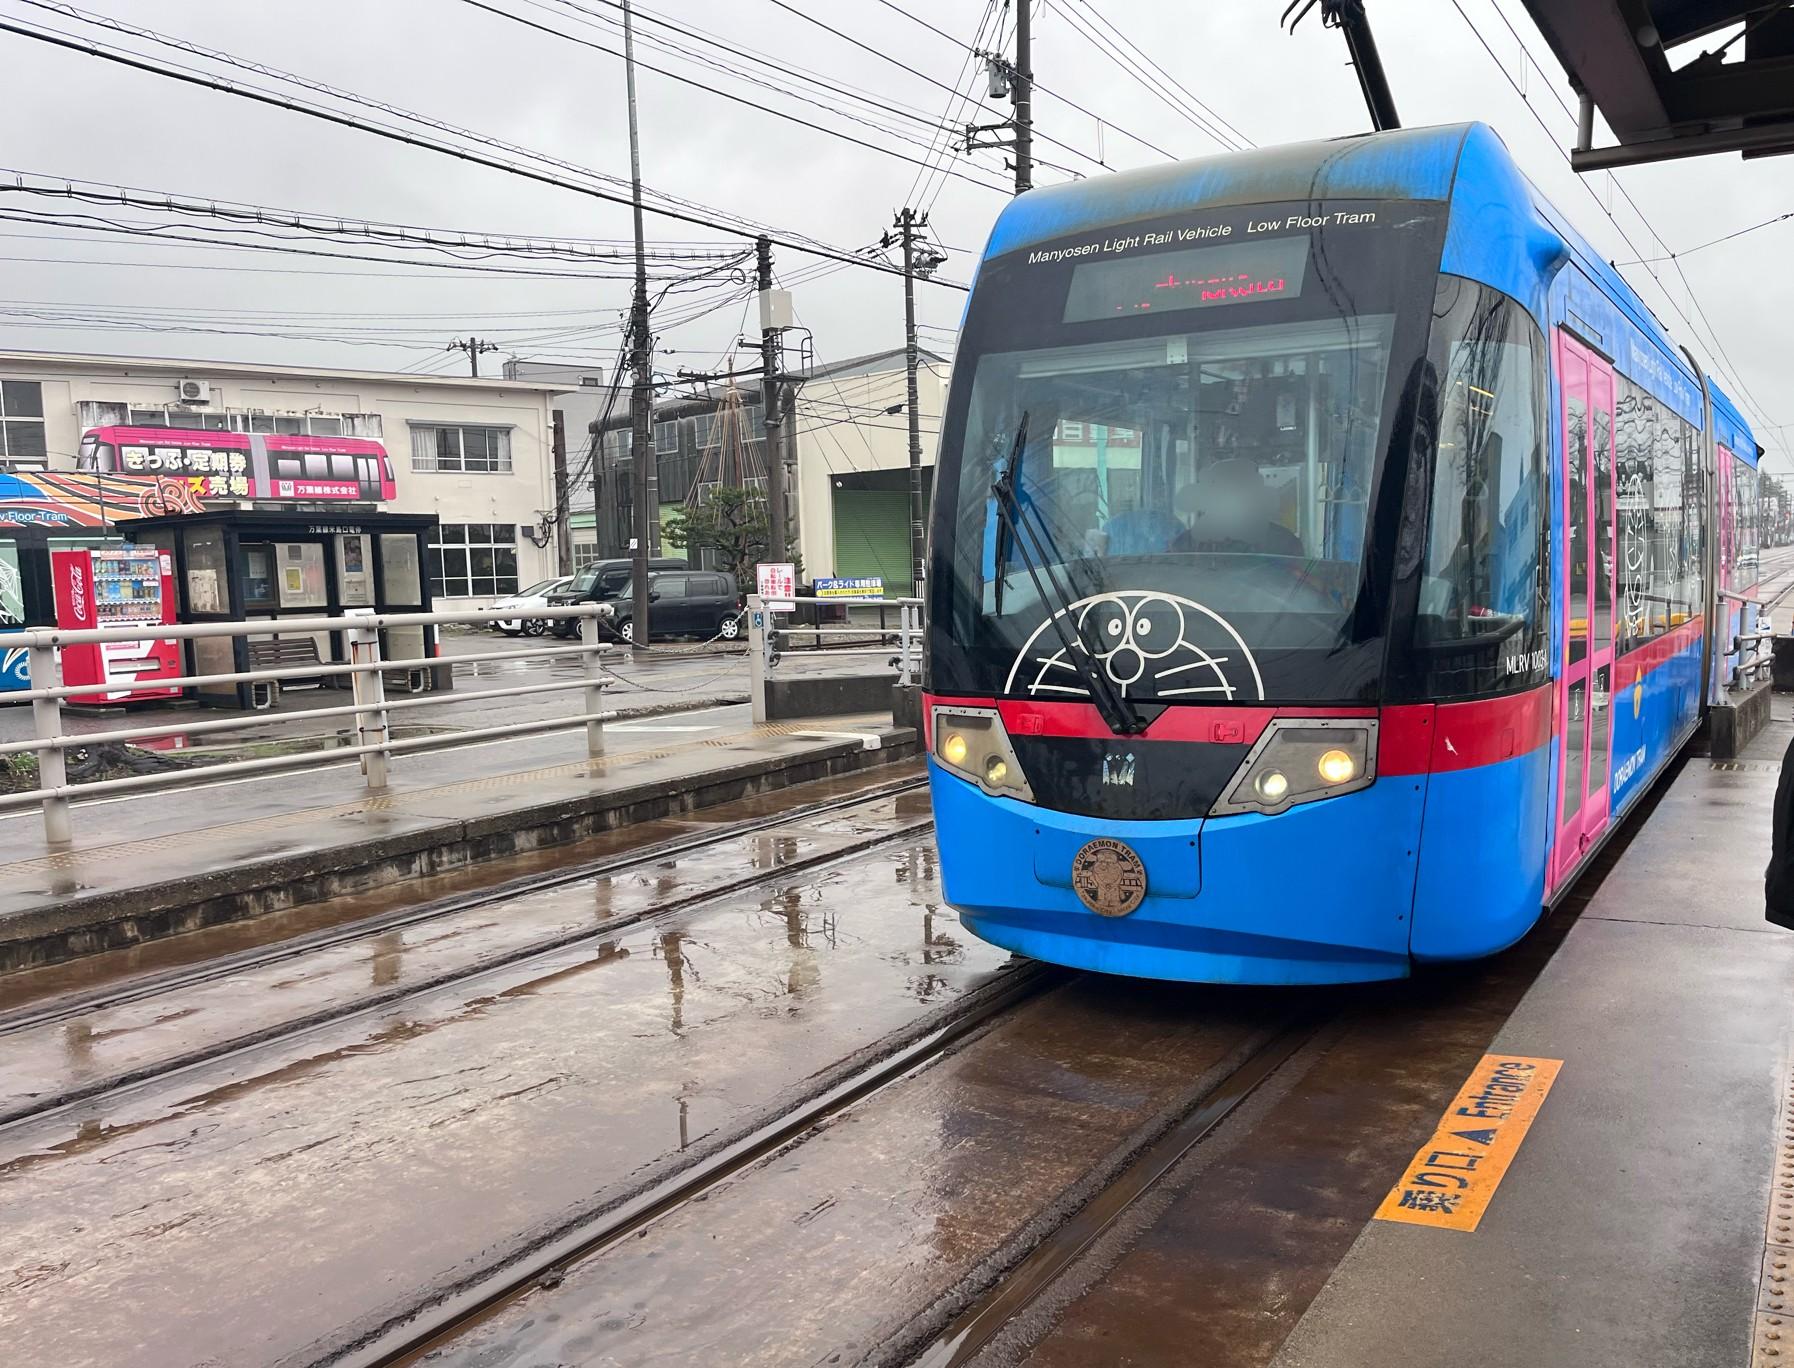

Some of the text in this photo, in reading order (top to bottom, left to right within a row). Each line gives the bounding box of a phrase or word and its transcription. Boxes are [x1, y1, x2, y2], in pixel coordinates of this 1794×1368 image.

[1028, 211, 1376, 265] Manyosen Light Rail Vehicle Low Floor Tram
[8, 511, 36, 521] Floor
[39, 511, 68, 521] Tram
[1506, 652, 1530, 675] MLRV
[1075, 840, 1141, 869] DORAEMON TRAM
[1456, 1062, 1537, 1121] Entrance
